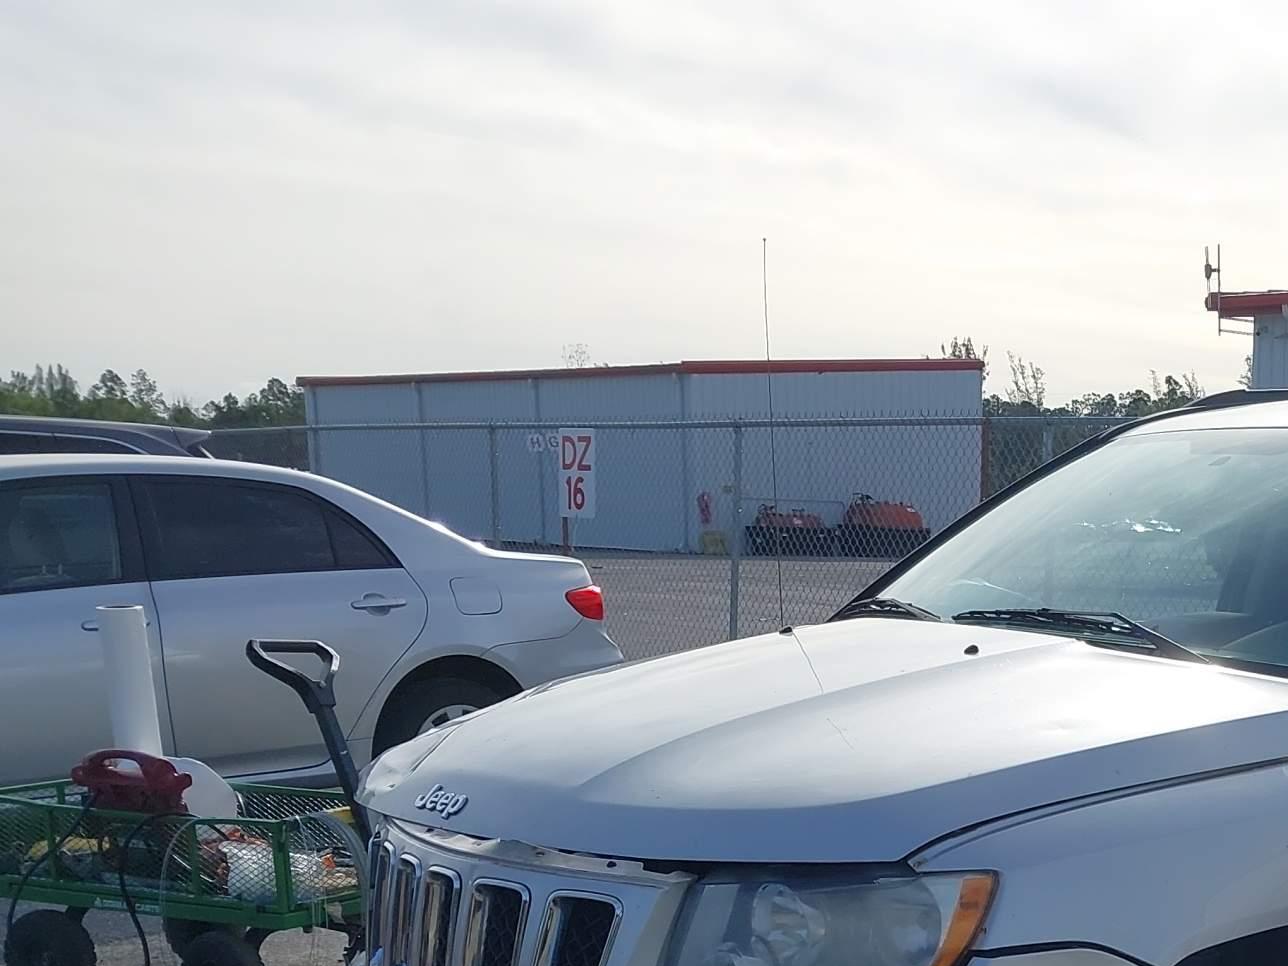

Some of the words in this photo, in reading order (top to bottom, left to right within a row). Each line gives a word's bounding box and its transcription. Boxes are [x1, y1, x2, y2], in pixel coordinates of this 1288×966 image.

[561, 435, 592, 472] DZ
[566, 475, 585, 511] 16
[414, 783, 468, 820] Jeep
